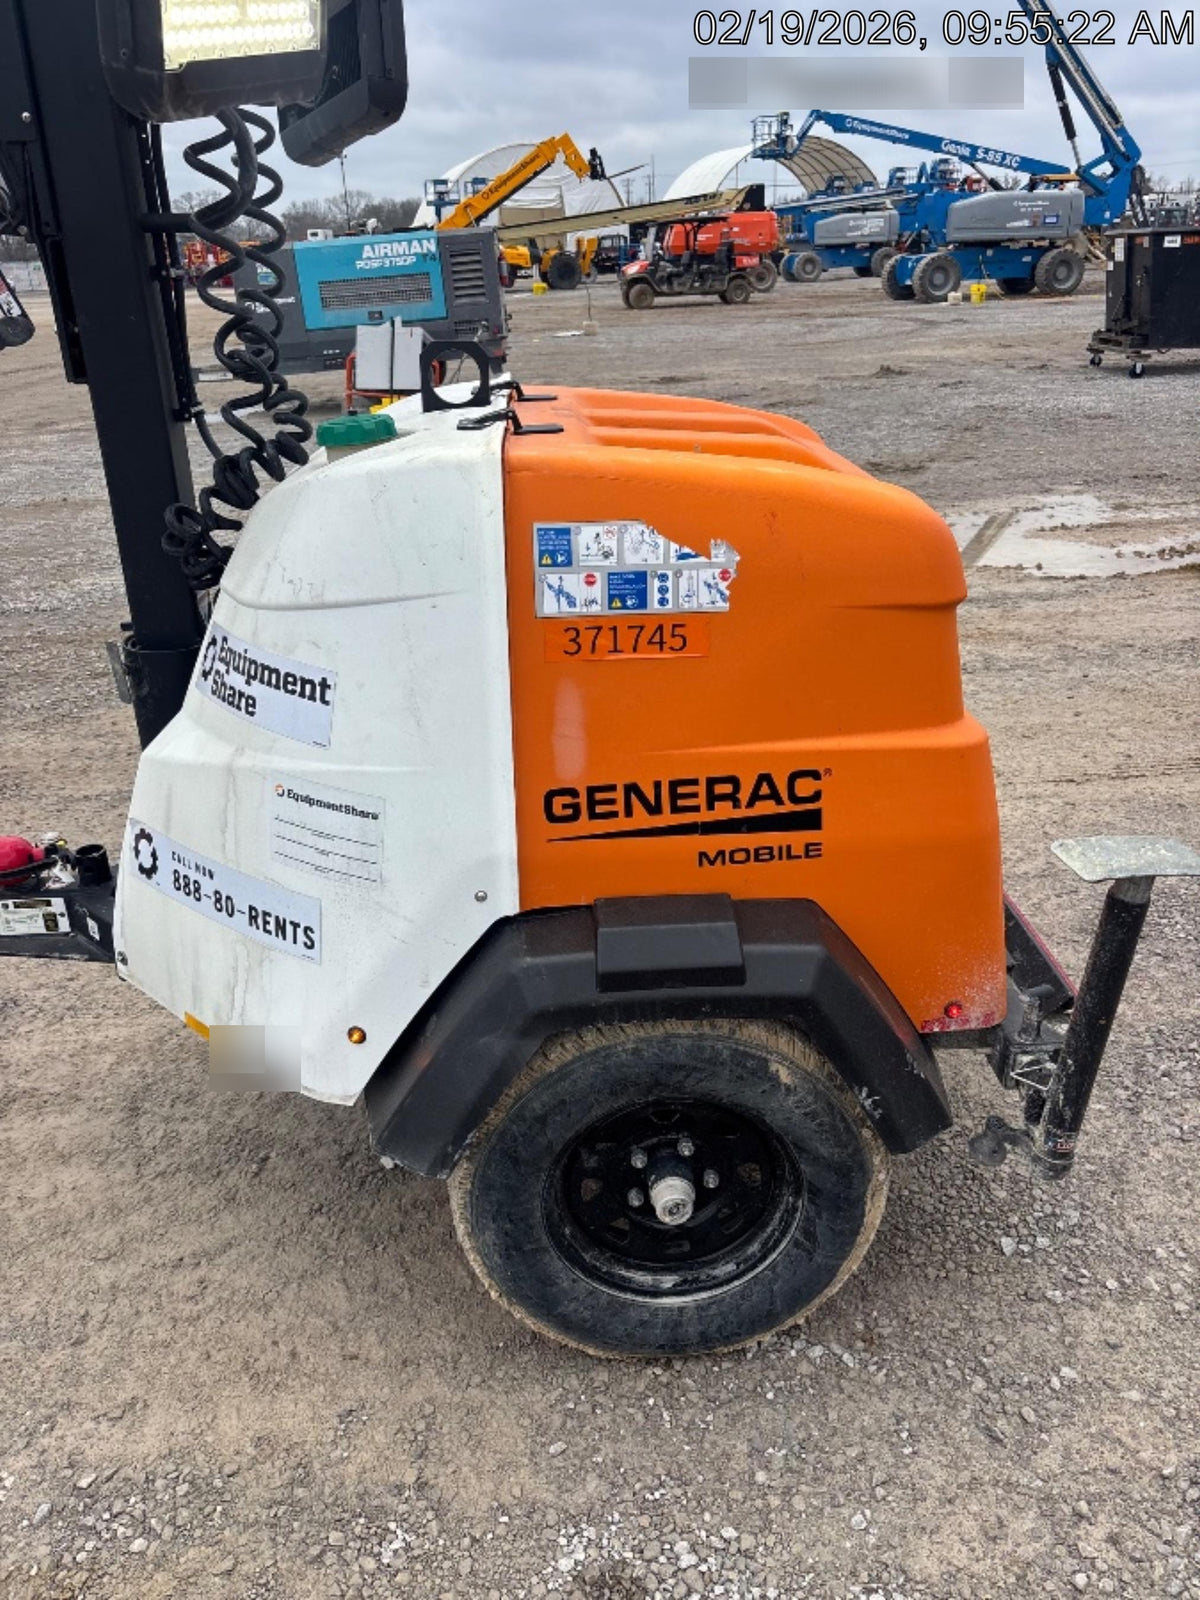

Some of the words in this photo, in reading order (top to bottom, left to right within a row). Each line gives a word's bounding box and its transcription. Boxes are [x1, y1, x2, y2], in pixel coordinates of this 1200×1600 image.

[941, 139, 971, 157] Genie
[1003, 154, 1021, 168] XC
[362, 238, 437, 259] AIRMAN
[563, 622, 688, 657] 371745
[218, 635, 332, 707] Equipment
[210, 671, 257, 718] Share
[287, 788, 380, 821] EquipmentShare
[543, 768, 823, 825] GENERAC
[171, 850, 193, 870] CALL
[195, 861, 215, 881] NOW
[698, 843, 823, 868] MOBILE
[172, 869, 316, 951] 888-80-RENTS
